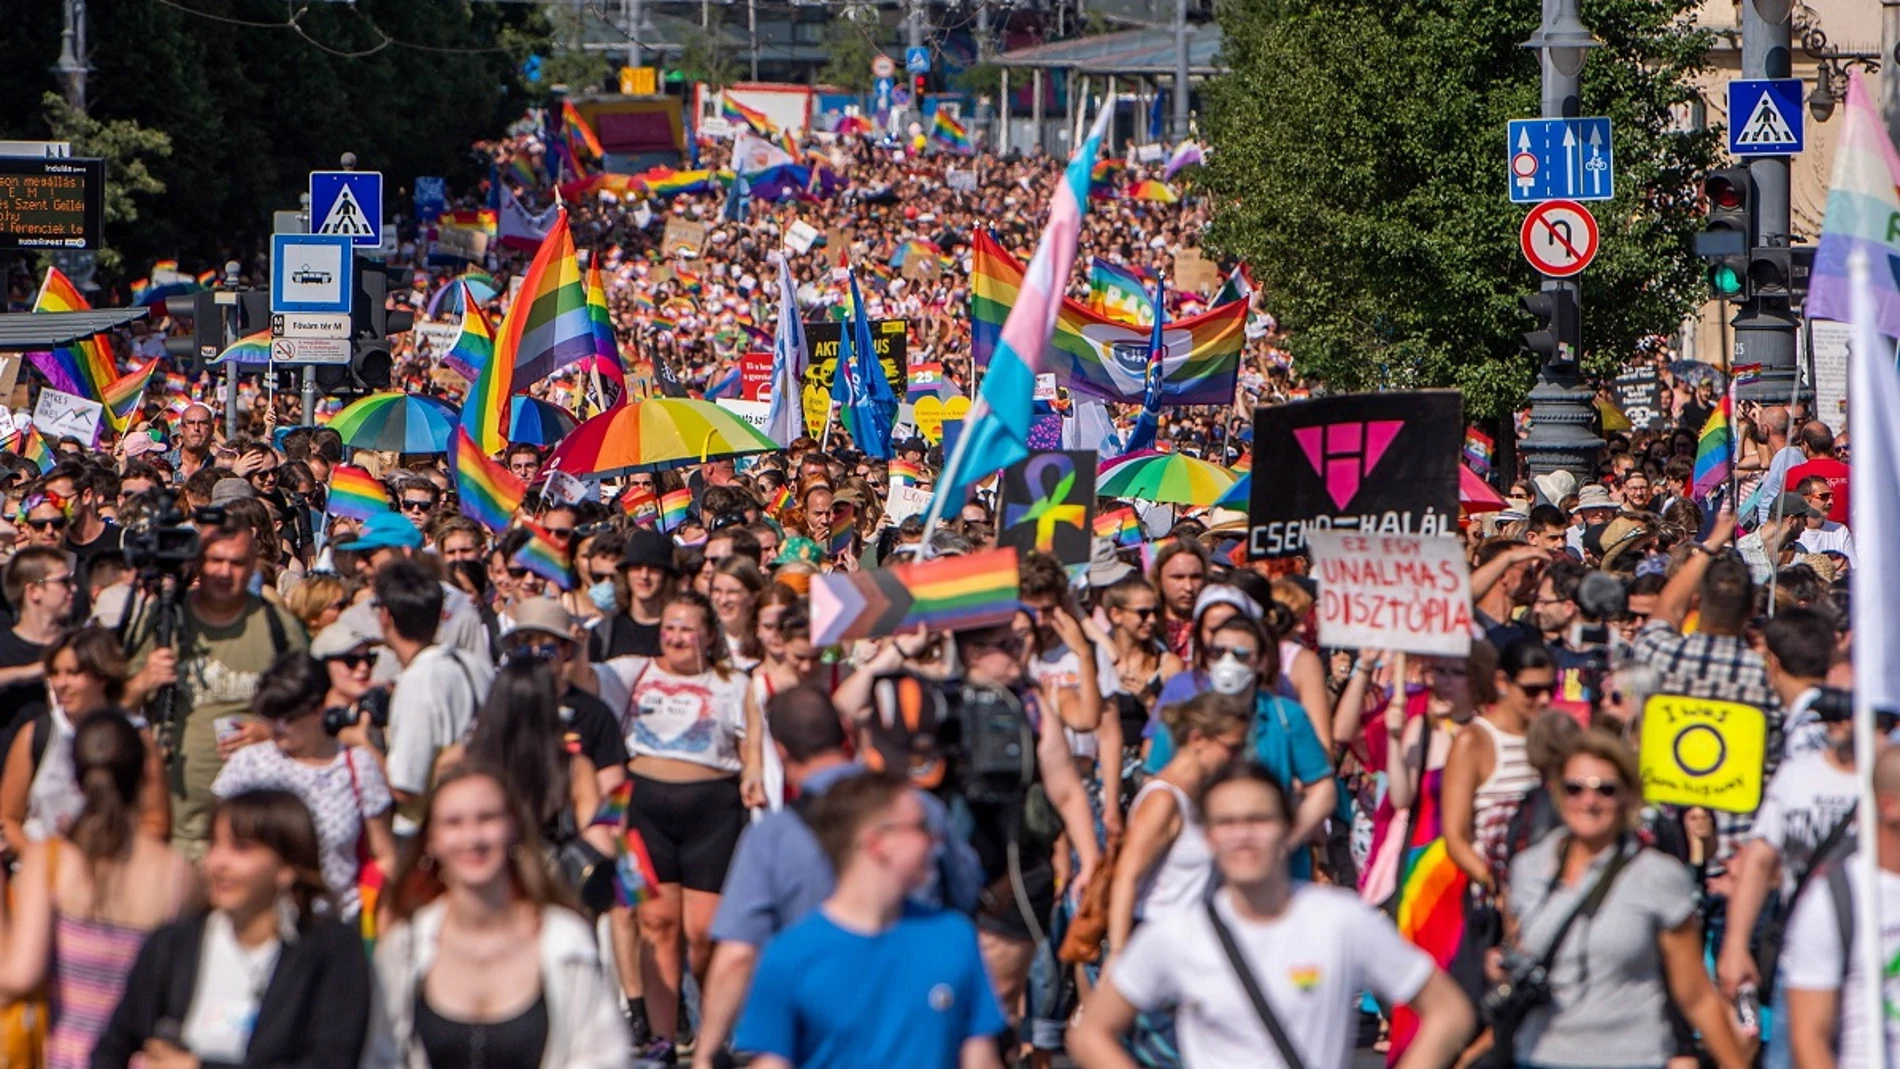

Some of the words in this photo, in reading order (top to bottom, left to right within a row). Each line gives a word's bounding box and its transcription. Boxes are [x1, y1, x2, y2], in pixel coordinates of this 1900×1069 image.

[15, 198, 48, 211] Szent
[915, 371, 934, 384] 25
[636, 500, 656, 517] 25
[1341, 536, 1370, 552] EZ
[1381, 536, 1422, 555] EGY
[1320, 557, 1461, 594] UNALMAS
[1322, 588, 1473, 635] DISZTÓPIA
[1663, 703, 1676, 723] I
